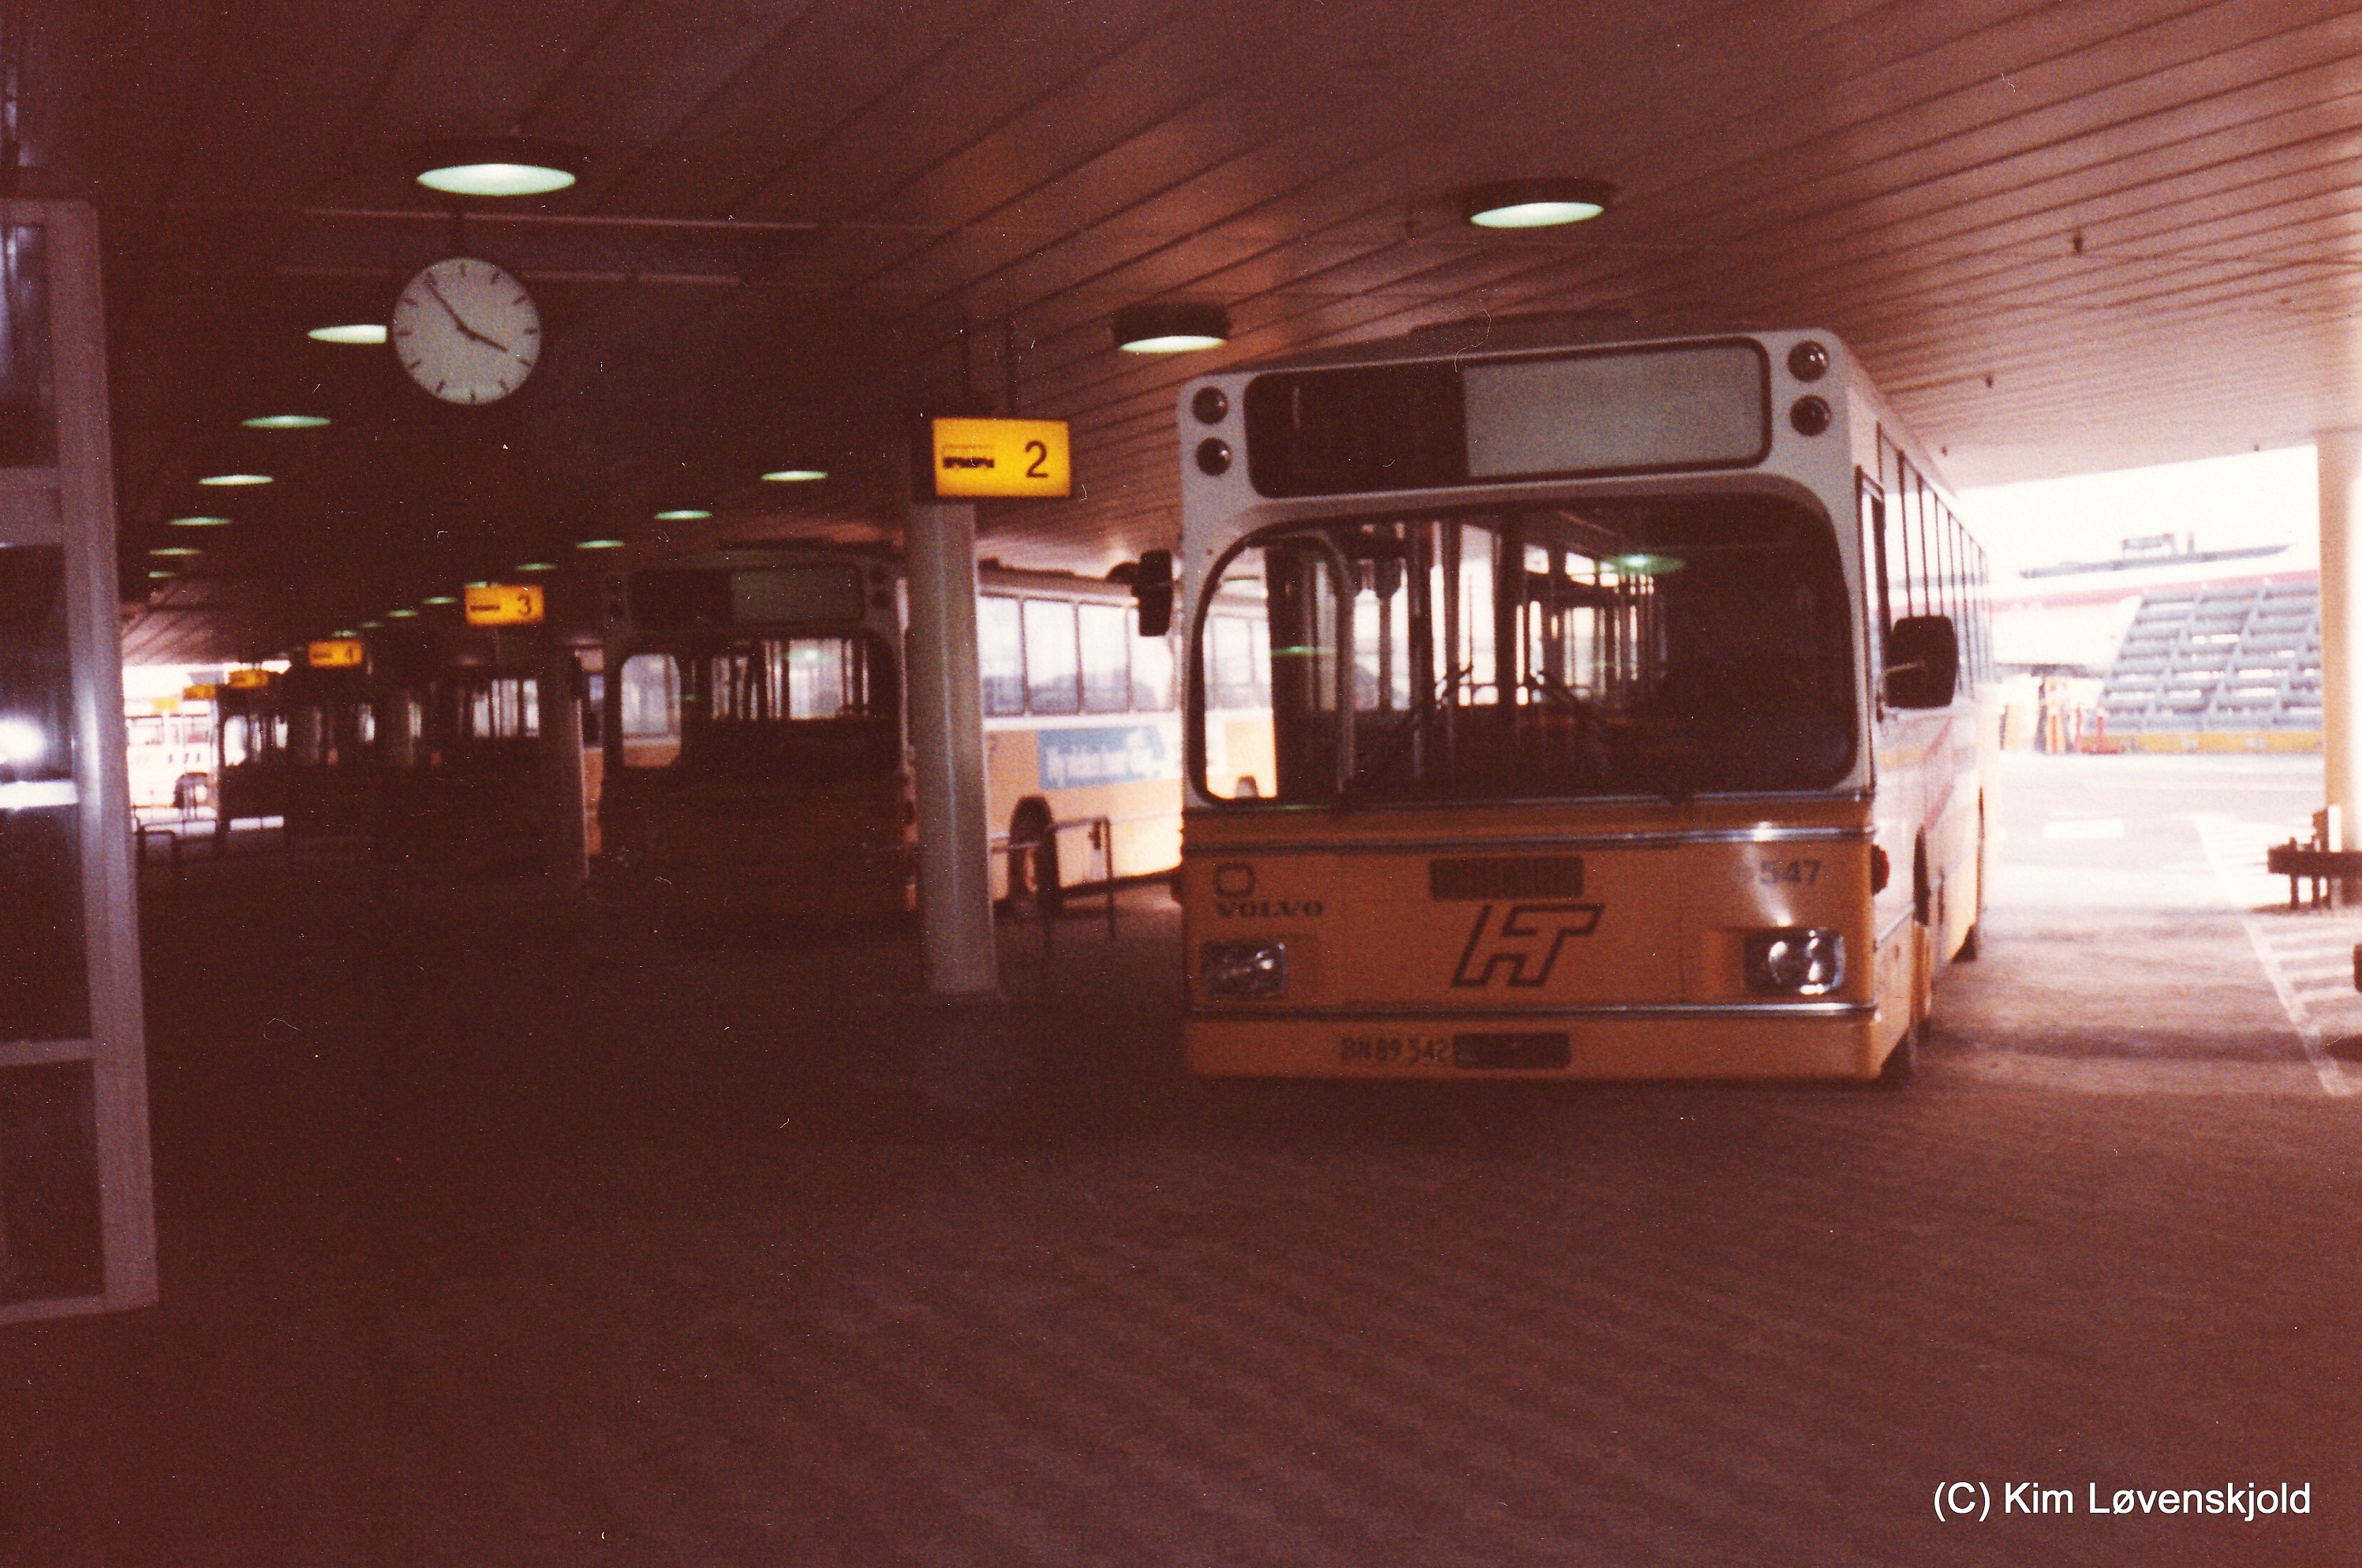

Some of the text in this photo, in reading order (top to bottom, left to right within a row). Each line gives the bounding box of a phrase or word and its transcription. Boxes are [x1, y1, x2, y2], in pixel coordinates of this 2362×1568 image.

[1025, 439, 1048, 478] 2
[518, 594, 532, 615] 3
[1216, 900, 1324, 918] VOLVO
[1450, 905, 1605, 988] HT
